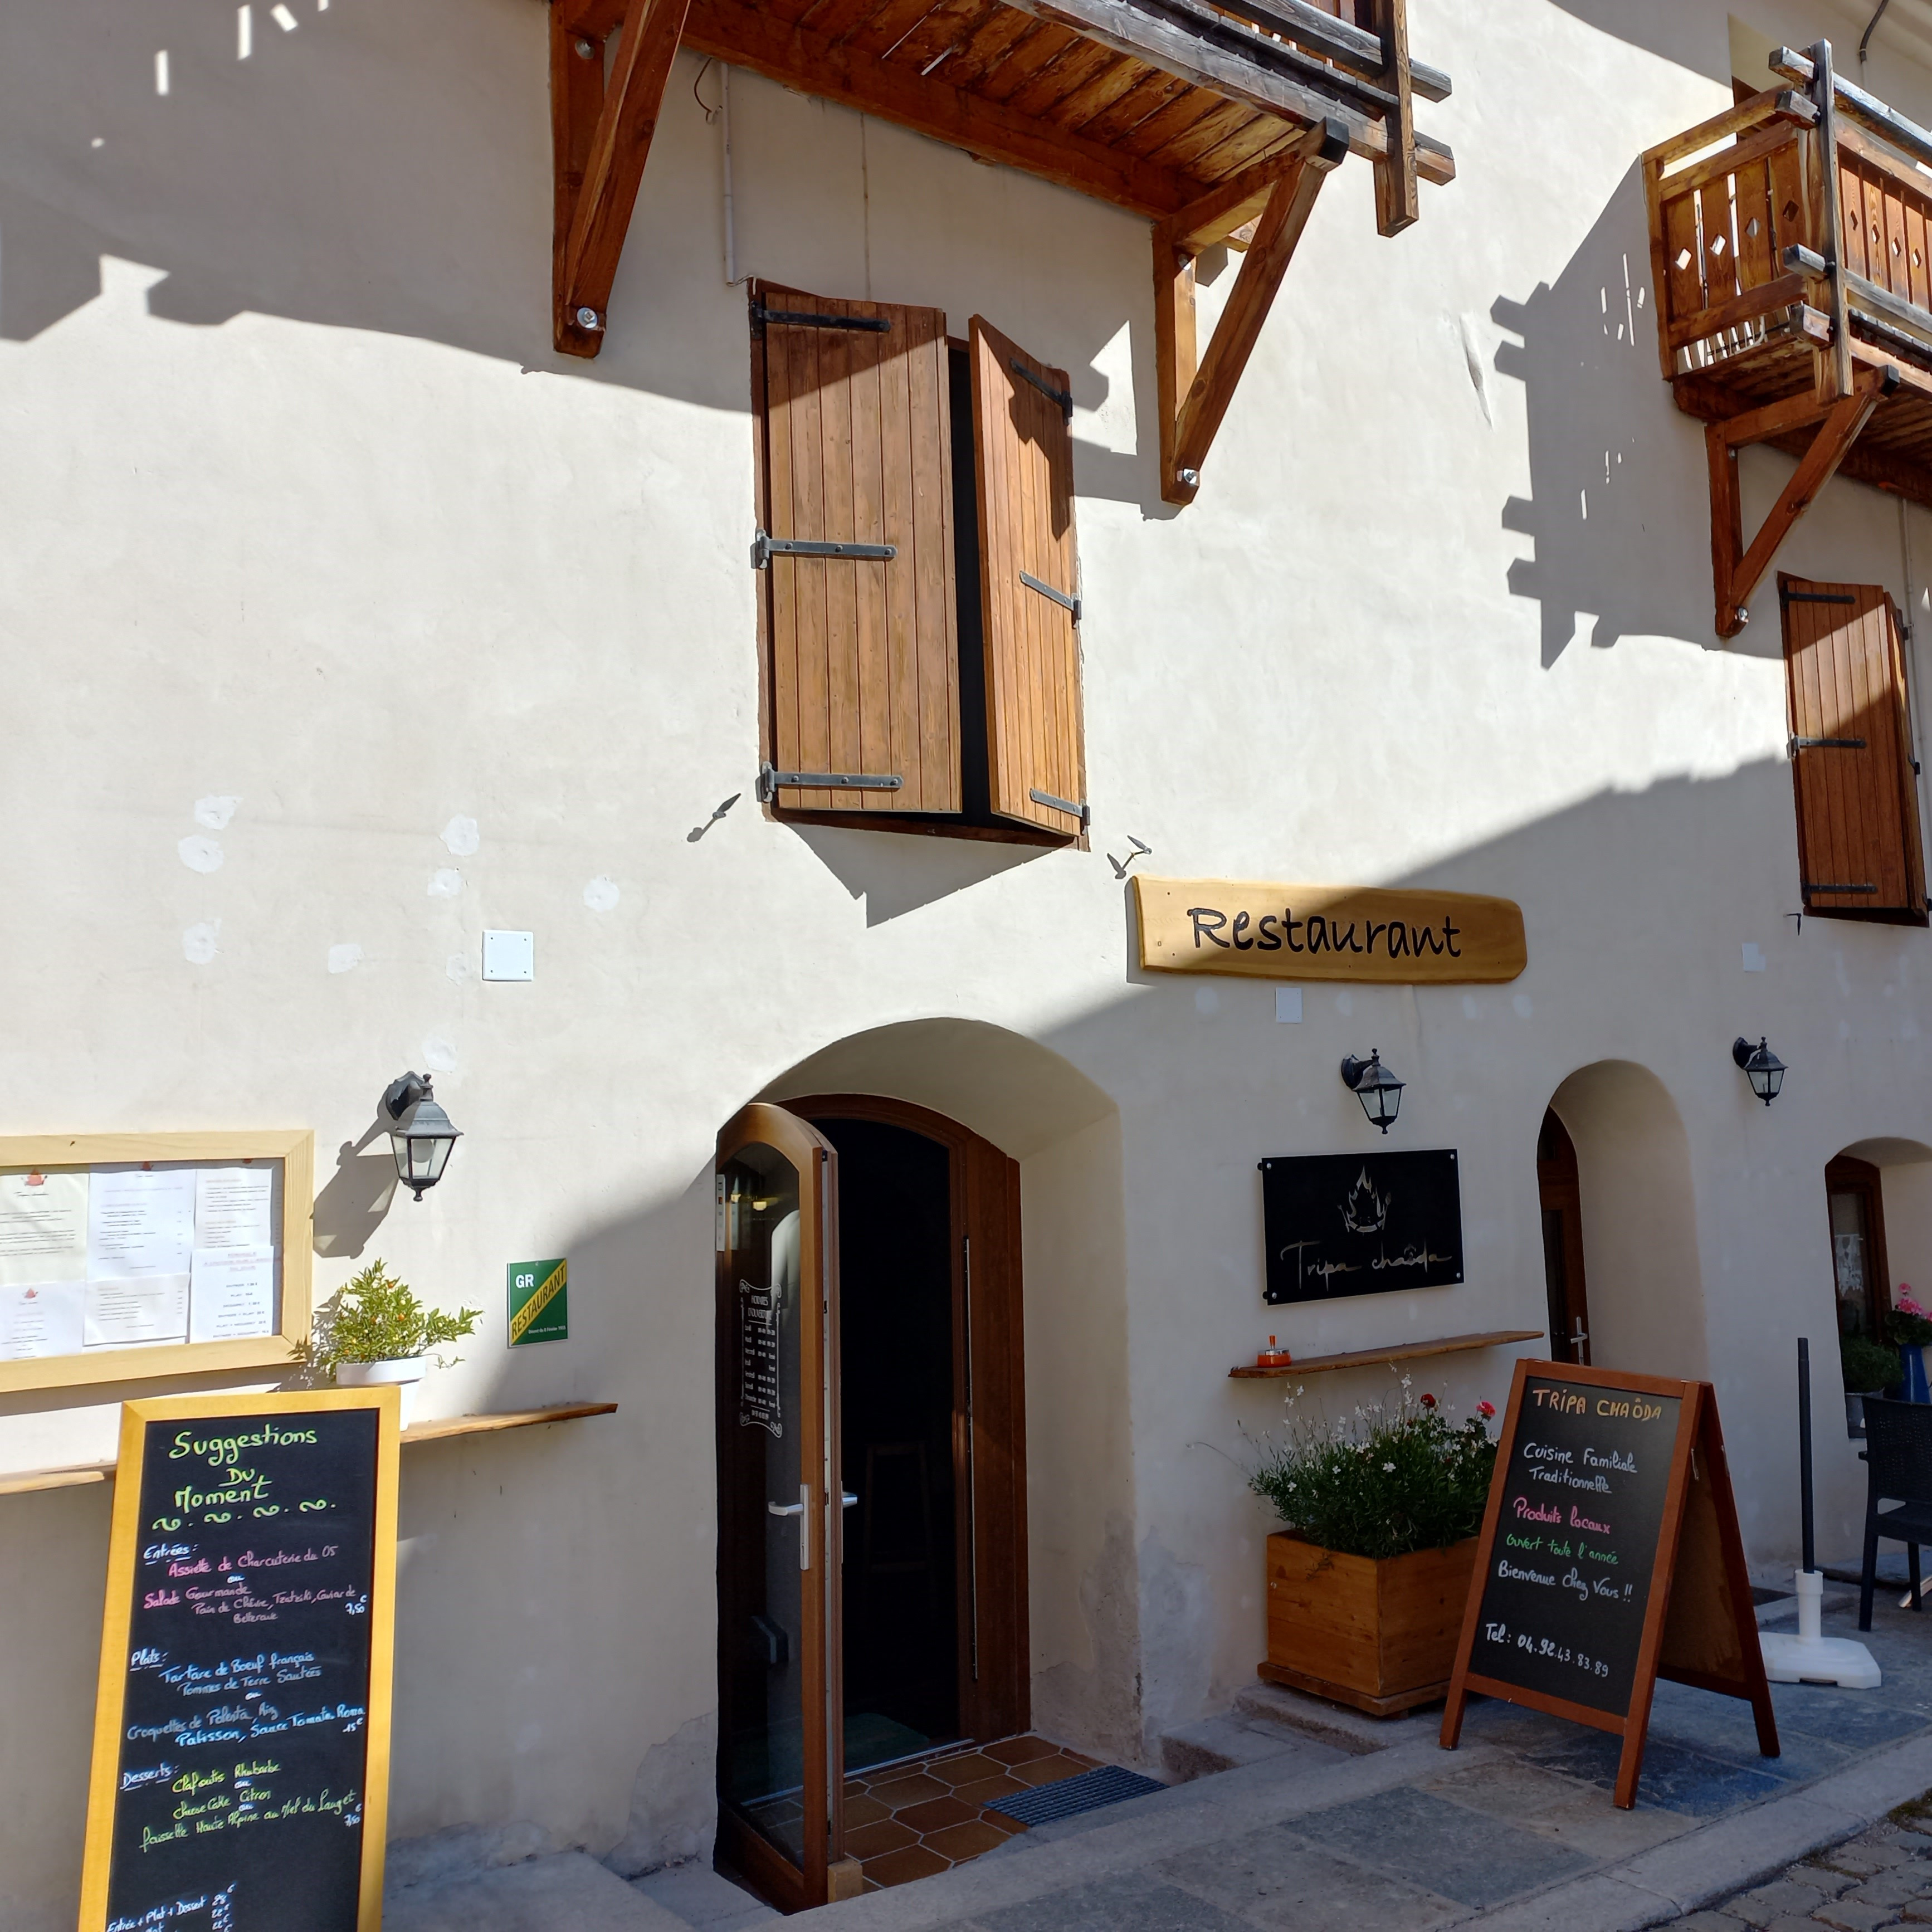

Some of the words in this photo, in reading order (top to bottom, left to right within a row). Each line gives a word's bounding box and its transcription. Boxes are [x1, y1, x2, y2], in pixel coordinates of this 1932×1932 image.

[1187, 907, 1462, 959] Restaurant
[1280, 1240, 1363, 1291] Tripa
[515, 1274, 535, 1289] GR
[511, 1264, 566, 1340] RESTAURANT
[168, 1424, 318, 1467] Suggestions
[1523, 1442, 1574, 1464] Cuisine
[1583, 1447, 1638, 1474] Familiale
[218, 1467, 256, 1487] Du
[1529, 1466, 1613, 1494] Traditionnelle
[174, 1475, 272, 1514] Moment
[1513, 1496, 1562, 1524] Produits
[1570, 1506, 1611, 1535] locaux
[168, 1558, 212, 1577] Assiette
[218, 1556, 233, 1571] de
[237, 1550, 301, 1567] Charcuterie
[304, 1548, 318, 1561] du
[1547, 1539, 1572, 1558] toute
[227, 1575, 245, 1583] ou
[1498, 1560, 1557, 1587] Bienvenue
[1593, 1577, 1619, 1599] Vous
[143, 1589, 180, 1609] Salade
[185, 1582, 252, 1600] Gourmande
[191, 1602, 216, 1614] Pain
[218, 1602, 231, 1613] de
[345, 1584, 357, 1597] de
[158, 1663, 212, 1683] Tartare
[215, 1662, 229, 1676] de
[177, 1681, 222, 1696] Pommes
[224, 1677, 240, 1690] de
[240, 1676, 271, 1687] Terre
[276, 1665, 321, 1684] Sautées
[127, 1719, 187, 1743] Croquettes
[189, 1715, 203, 1729] de
[250, 1721, 289, 1738] Sauce
[172, 1769, 226, 1796] Clafoutis
[234, 1759, 281, 1779] Rhubarbe
[234, 1780, 252, 1789] ou
[238, 1803, 255, 1812] ou
[240, 1787, 271, 1802] Citron
[196, 1815, 225, 1833] Haute
[228, 1809, 260, 1828] Alpine
[264, 1810, 280, 1820] au
[281, 1796, 302, 1819] Miel
[301, 1797, 315, 1813] du
[145, 1906, 167, 1924] Plat
[176, 1895, 207, 1916] Dessert
